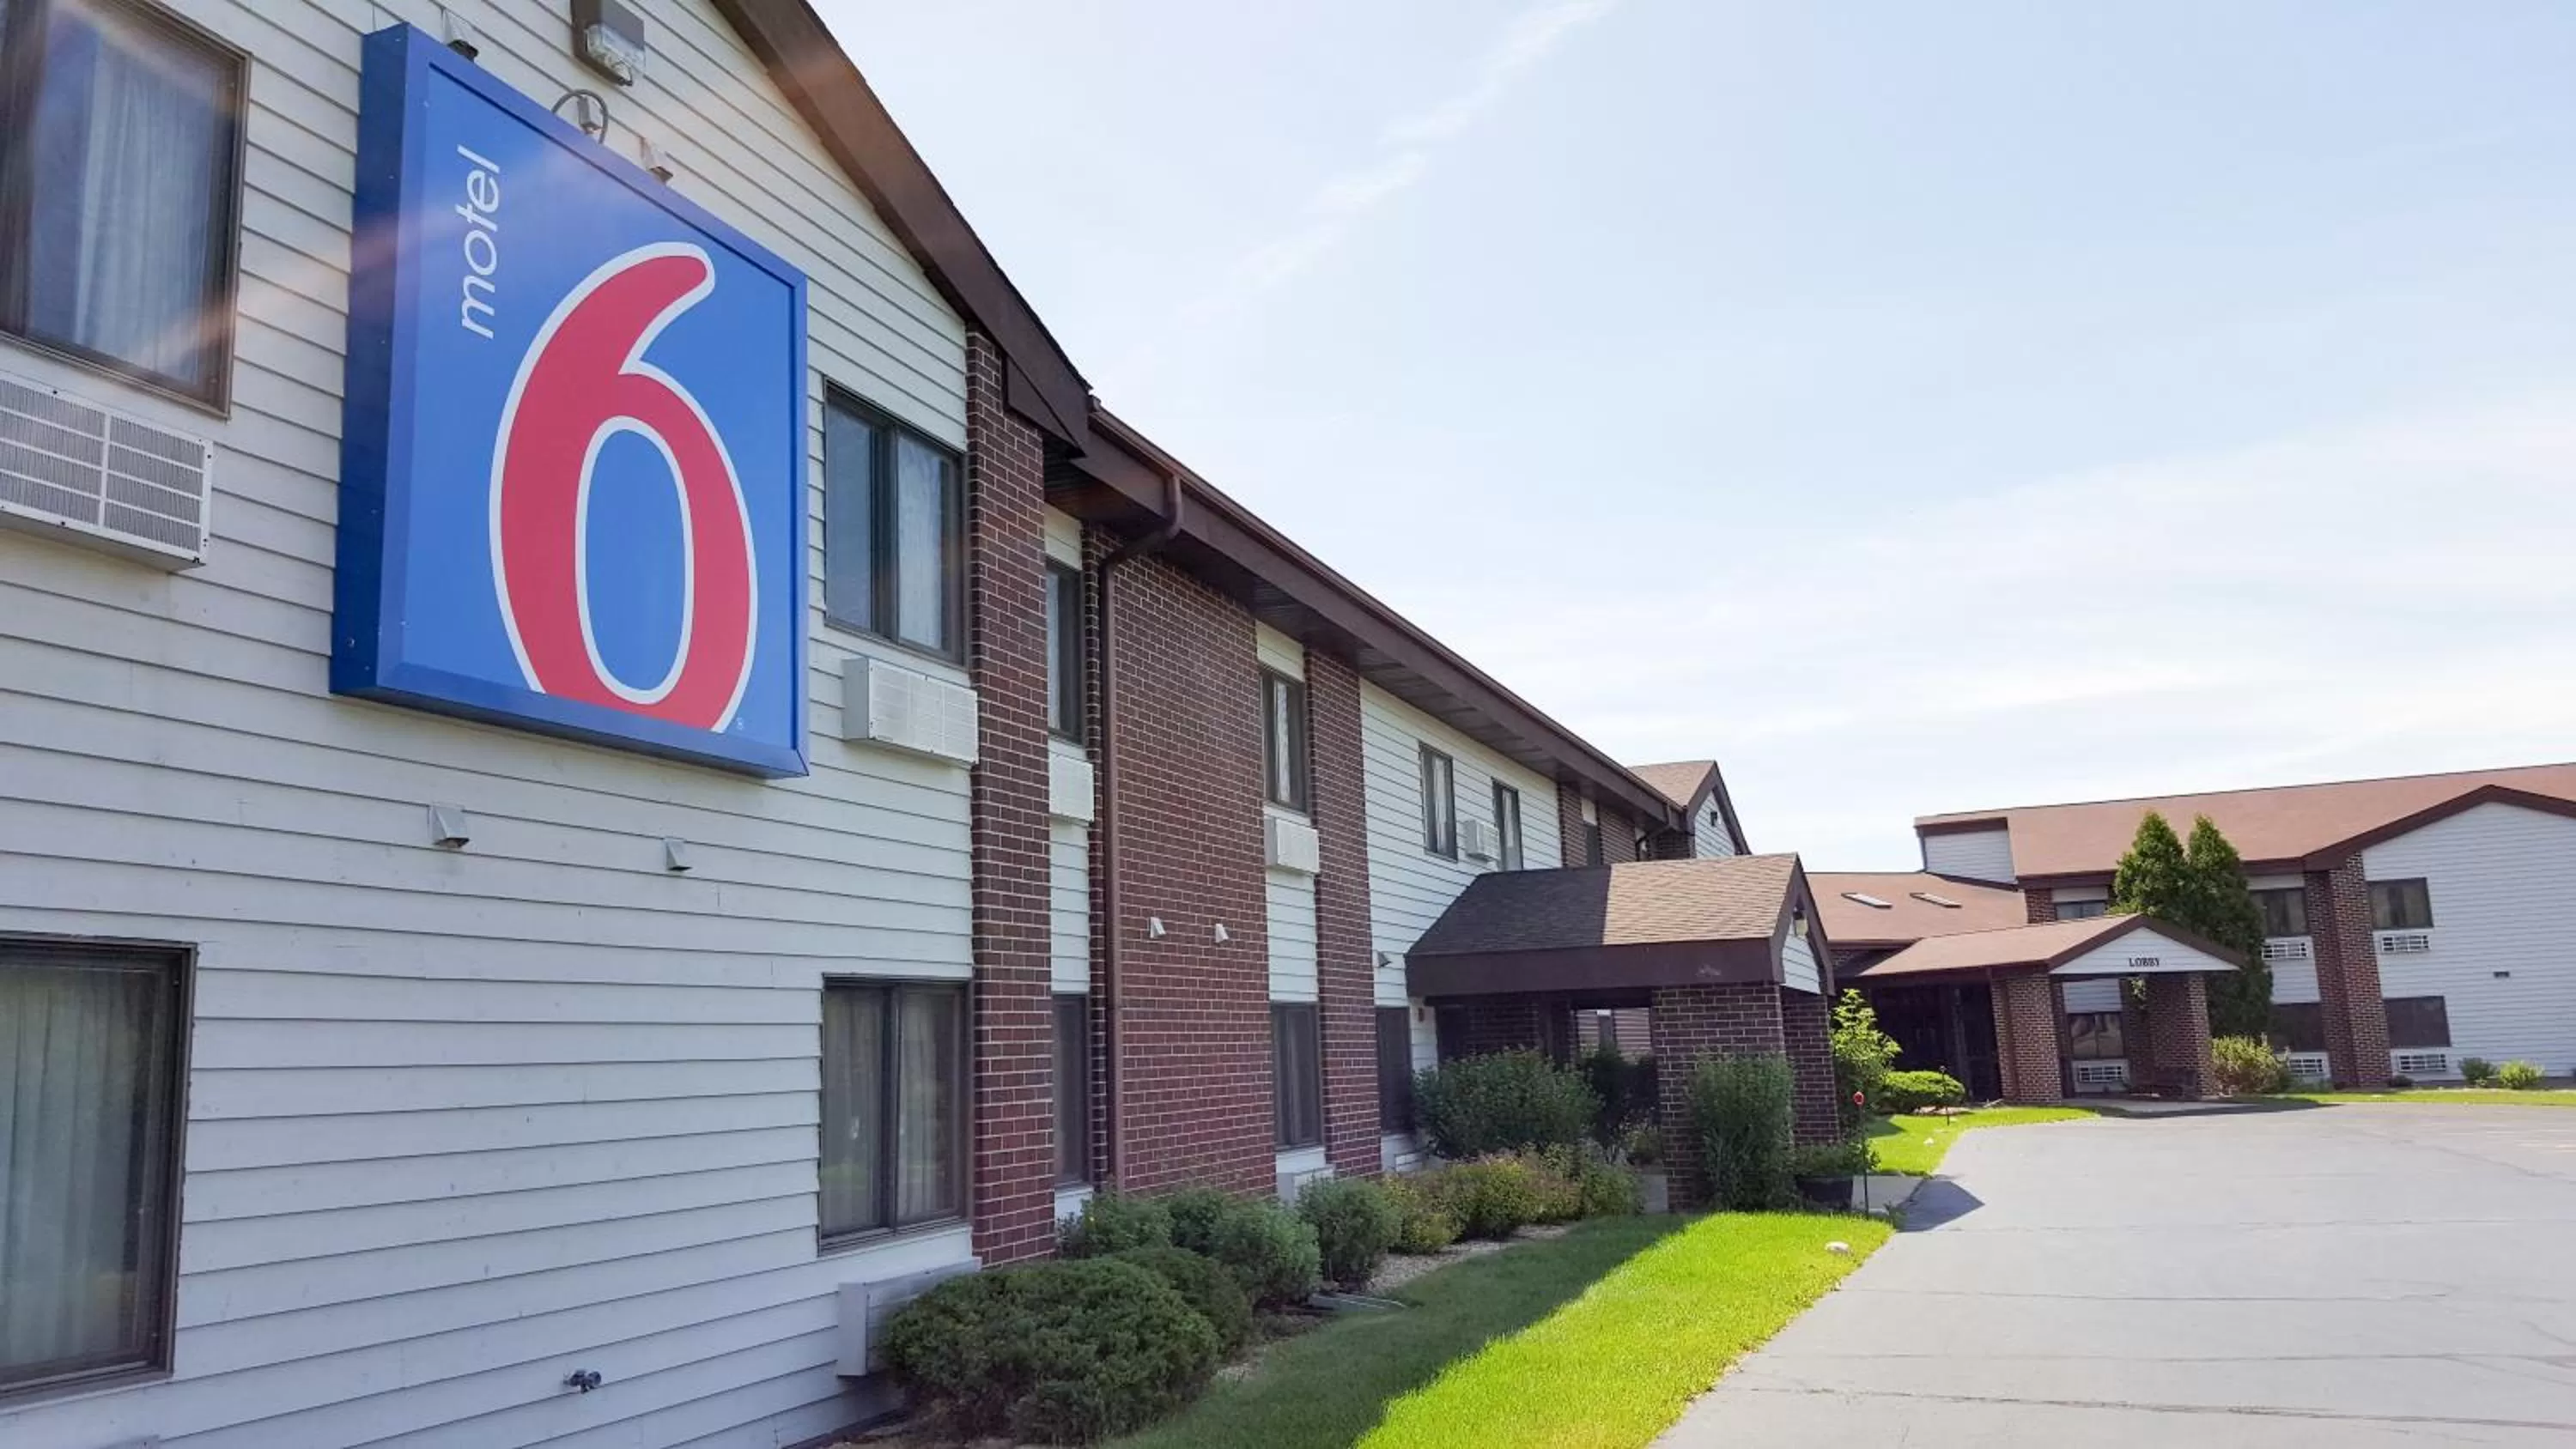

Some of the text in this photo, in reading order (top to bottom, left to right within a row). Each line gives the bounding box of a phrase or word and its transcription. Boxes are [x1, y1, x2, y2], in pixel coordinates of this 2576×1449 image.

[458, 146, 501, 339] motel
[490, 241, 757, 733] 6
[2129, 957, 2160, 967] LOBBY
